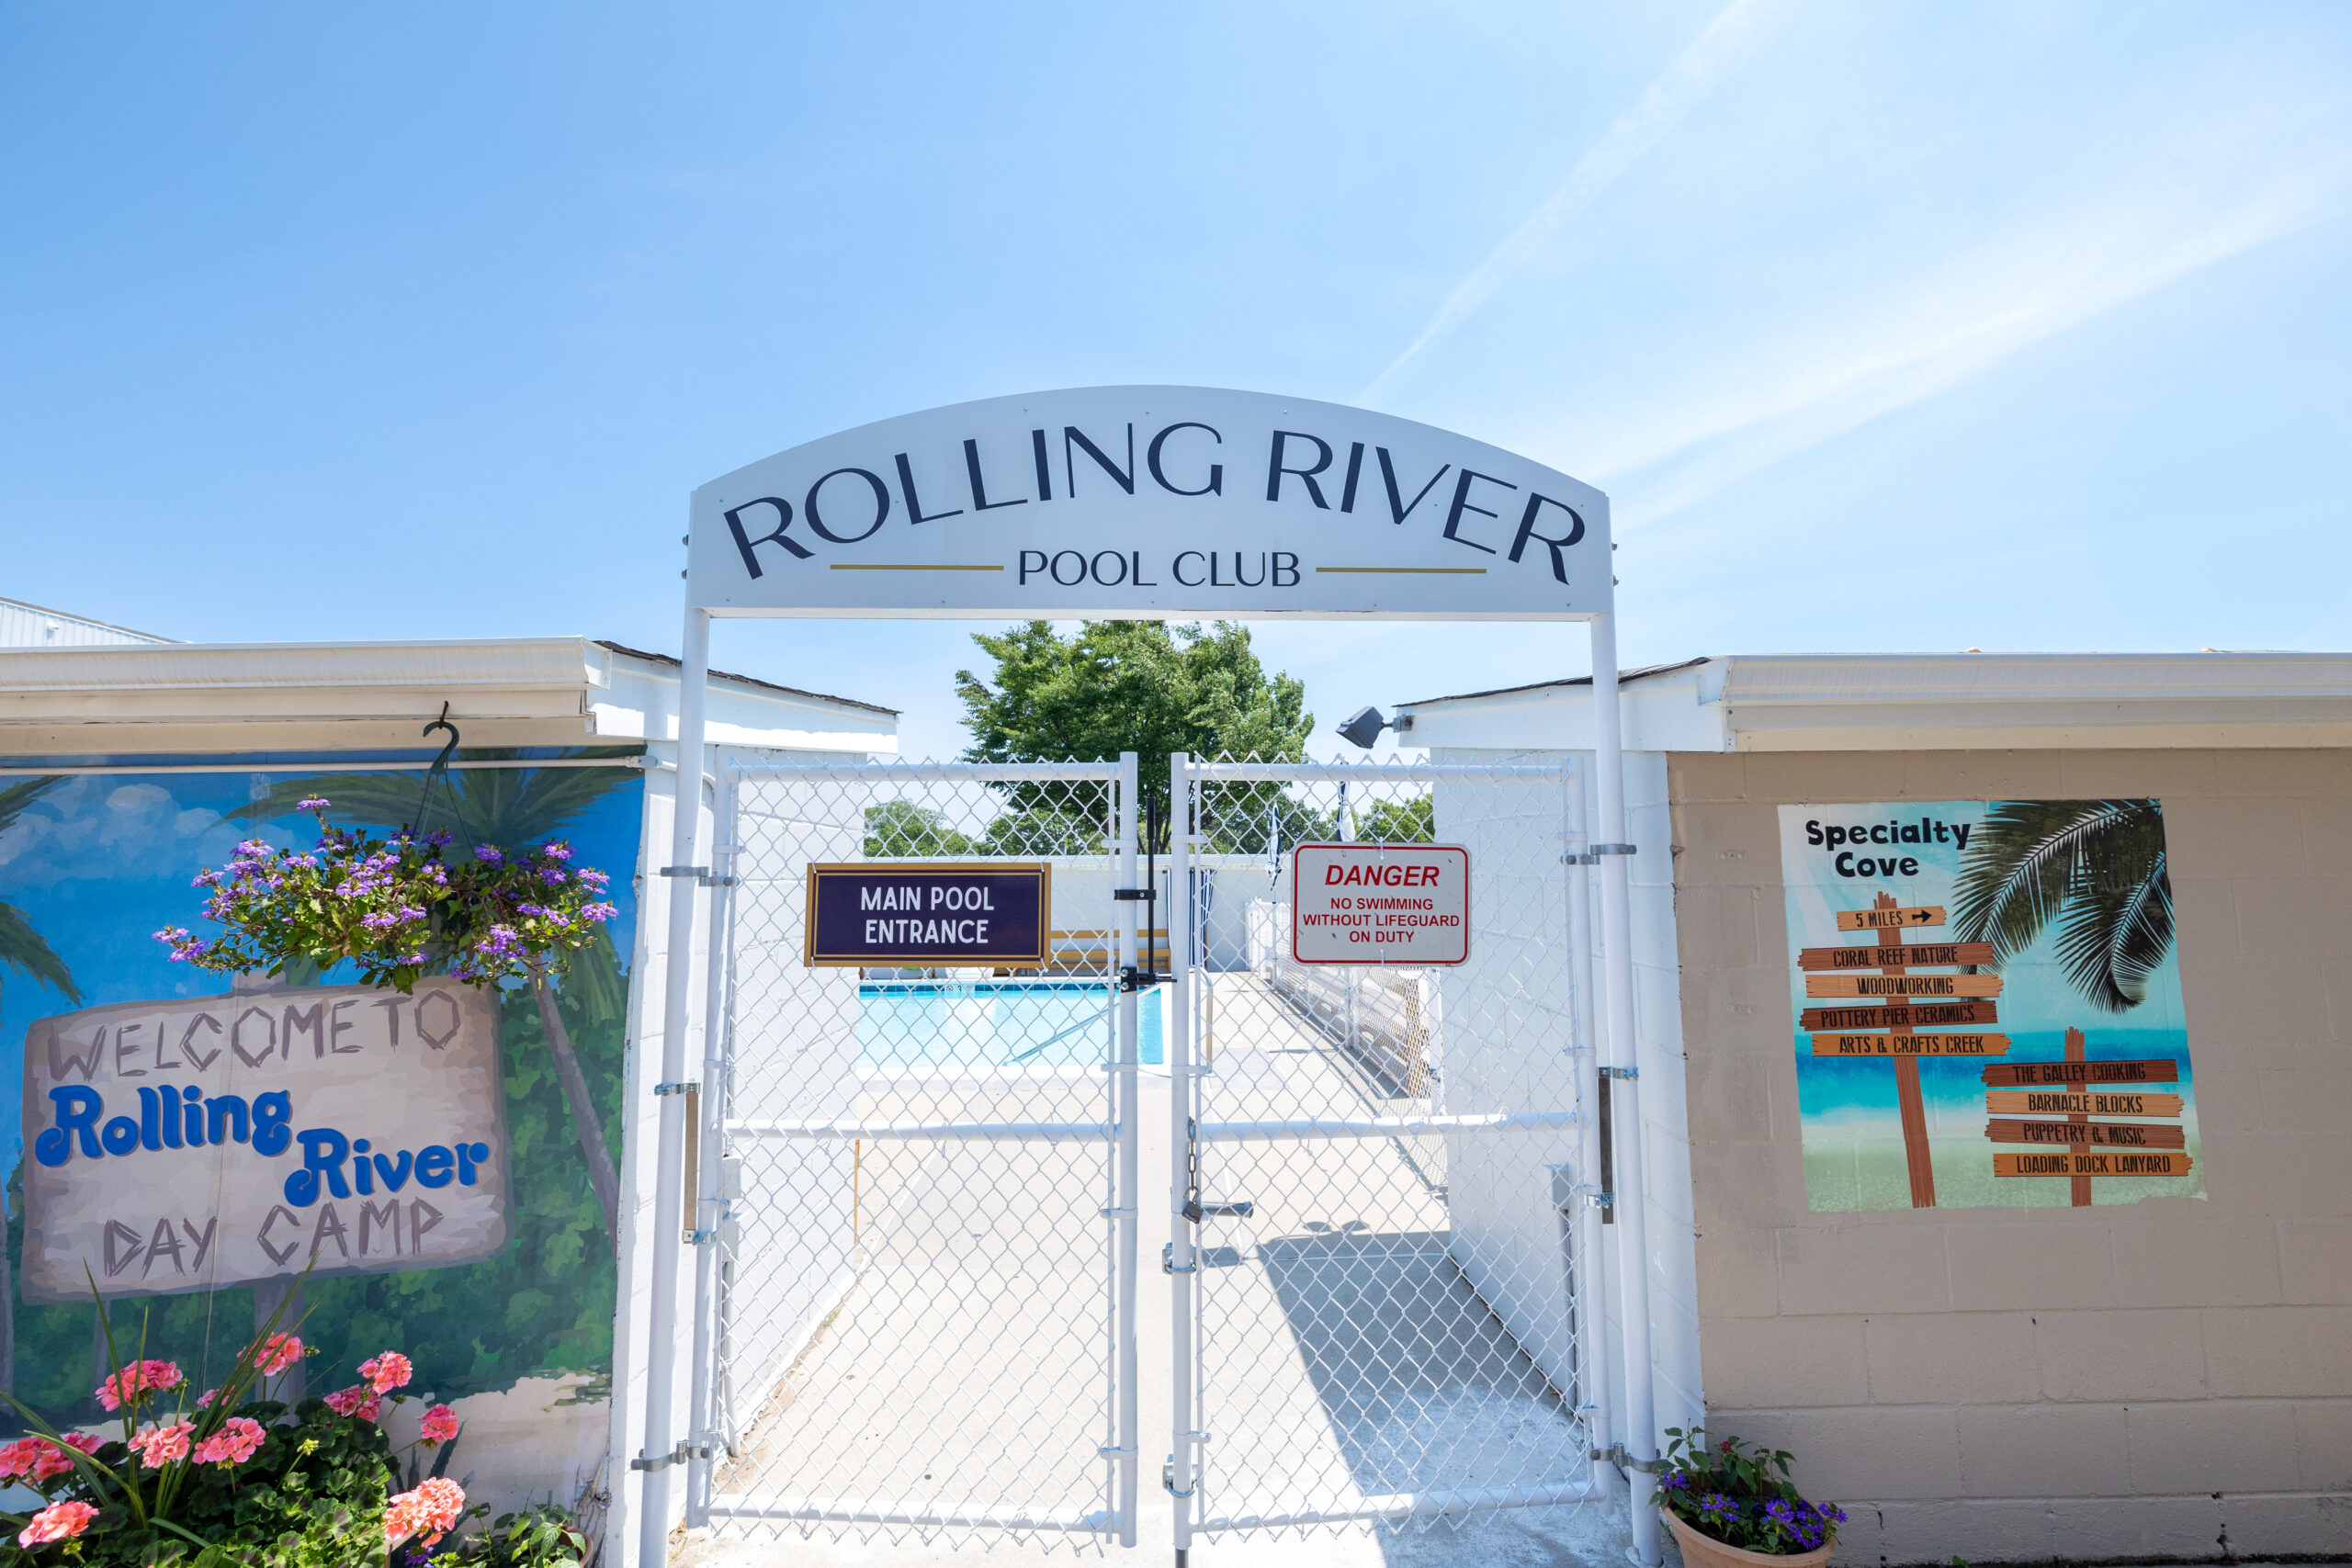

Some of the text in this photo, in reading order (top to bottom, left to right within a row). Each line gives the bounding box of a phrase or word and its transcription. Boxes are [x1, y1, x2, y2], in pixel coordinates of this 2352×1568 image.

[723, 422, 1586, 586] ROLLING RIVER
[1019, 550, 1301, 587] POOL CLUB
[1805, 818, 1971, 851] Specialty
[1325, 865, 1440, 886] DANGER
[1835, 852, 1919, 877] Cove
[861, 886, 994, 910] MAIN POOL
[1331, 898, 1433, 910] NO SWIMMING
[1303, 914, 1460, 926] WITHOUT LIFEGUARD
[1856, 910, 1903, 928] 5 MILES
[865, 919, 989, 943] ENTRANCE
[1350, 931, 1415, 942] ON DUTY
[1833, 946, 1958, 967] CORAL REEF NATURE
[1857, 977, 1953, 995] WOODWORKING
[1821, 1005, 1974, 1028] POTTERY PIER CERAMICS
[49, 989, 461, 1081] WELCOME TO
[1839, 1036, 1984, 1054] ARTS & CRAFTS CREEK
[2013, 1063, 2145, 1083] THE GALLEY COOKING
[2029, 1094, 2143, 1112] BARNACLE BLOCKS
[35, 1084, 293, 1167] Rolling
[2023, 1123, 2146, 1145] PUPPETRY & MUSIC
[283, 1127, 490, 1208] River
[2017, 1156, 2170, 1173] LOADING DOCK LANYARD
[104, 1197, 445, 1281] DAY CAMP
